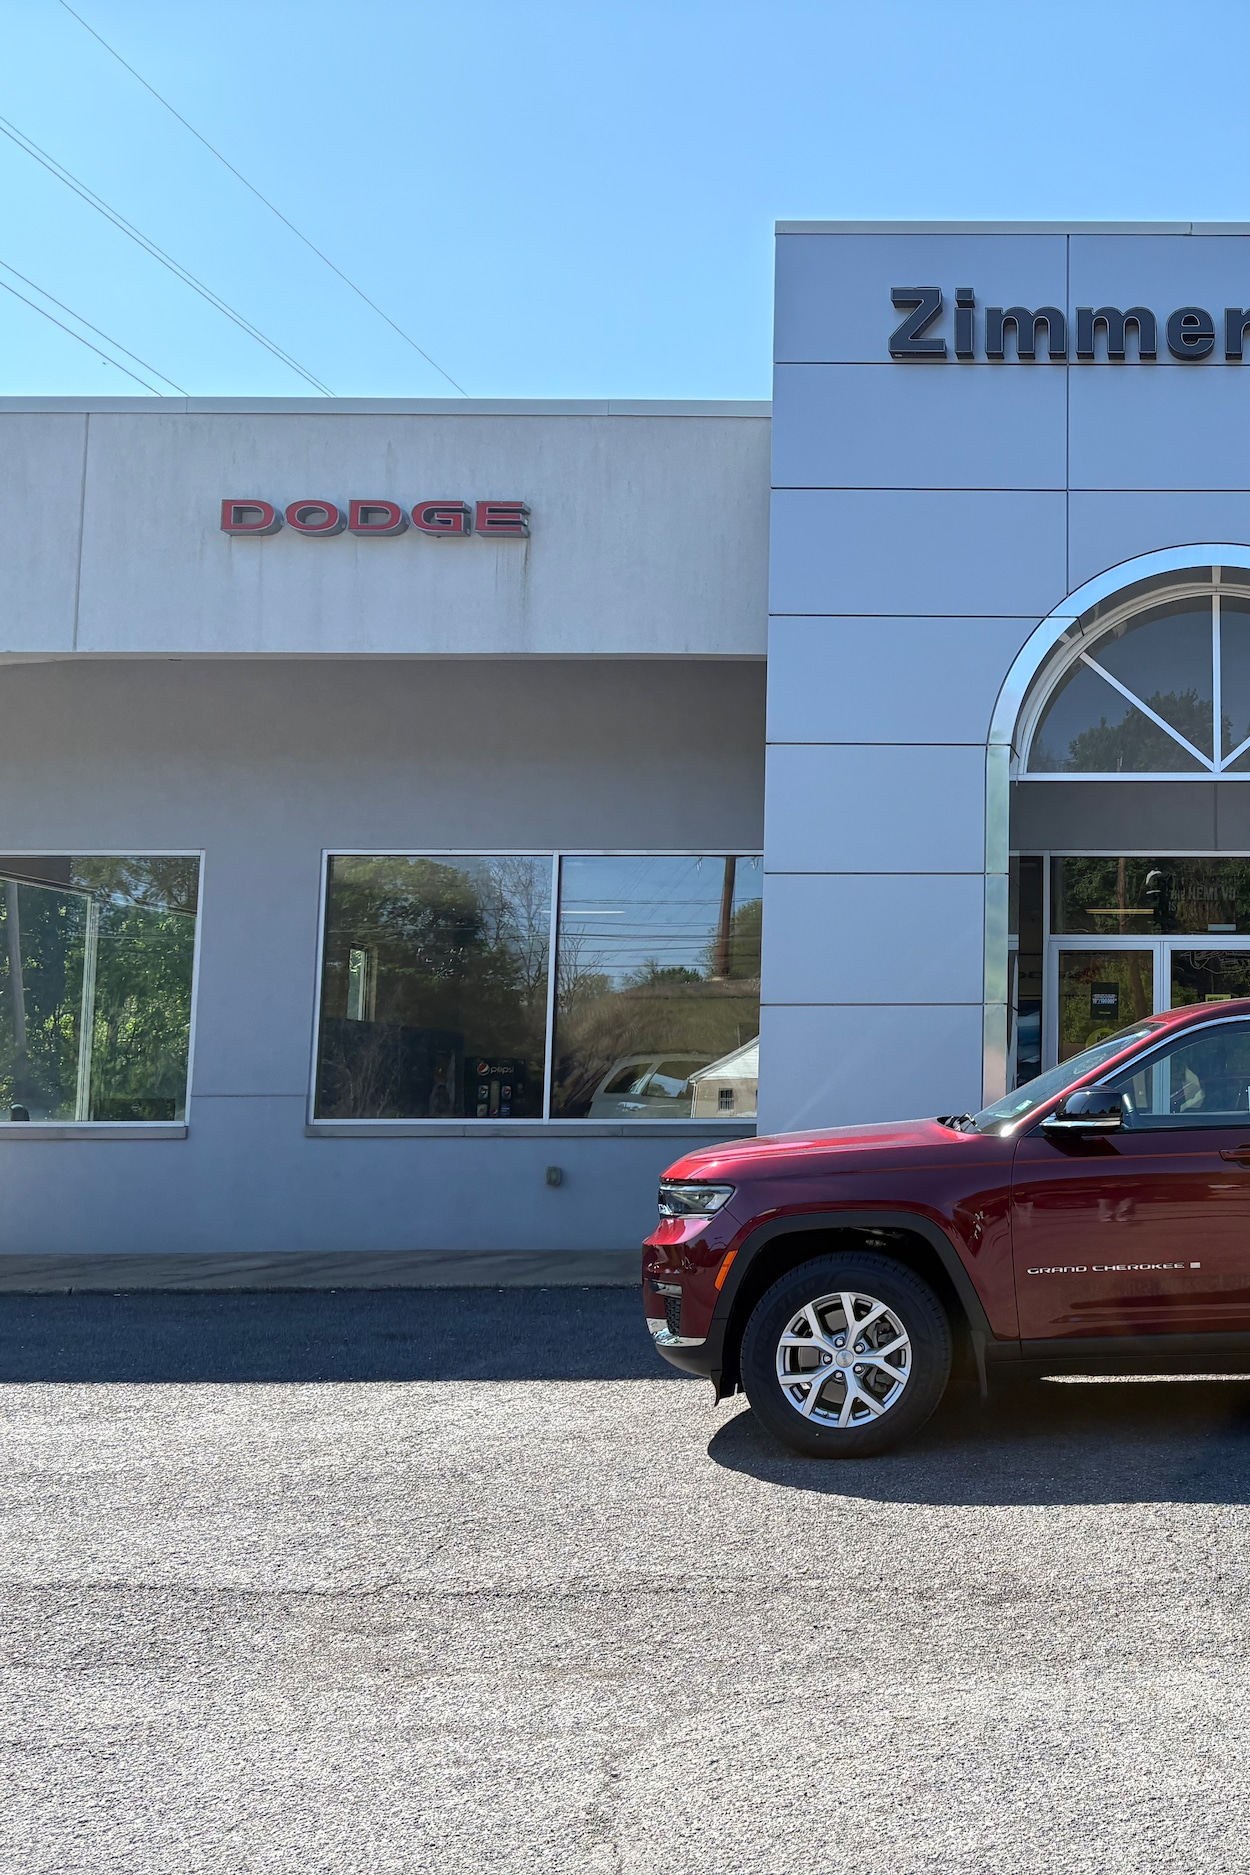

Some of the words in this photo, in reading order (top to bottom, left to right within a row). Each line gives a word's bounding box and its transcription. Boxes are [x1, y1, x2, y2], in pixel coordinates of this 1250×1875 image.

[220, 499, 530, 537] DODGE
[1027, 1265, 1088, 1275] GRAND
[1092, 1262, 1185, 1272] CHEROKEE
